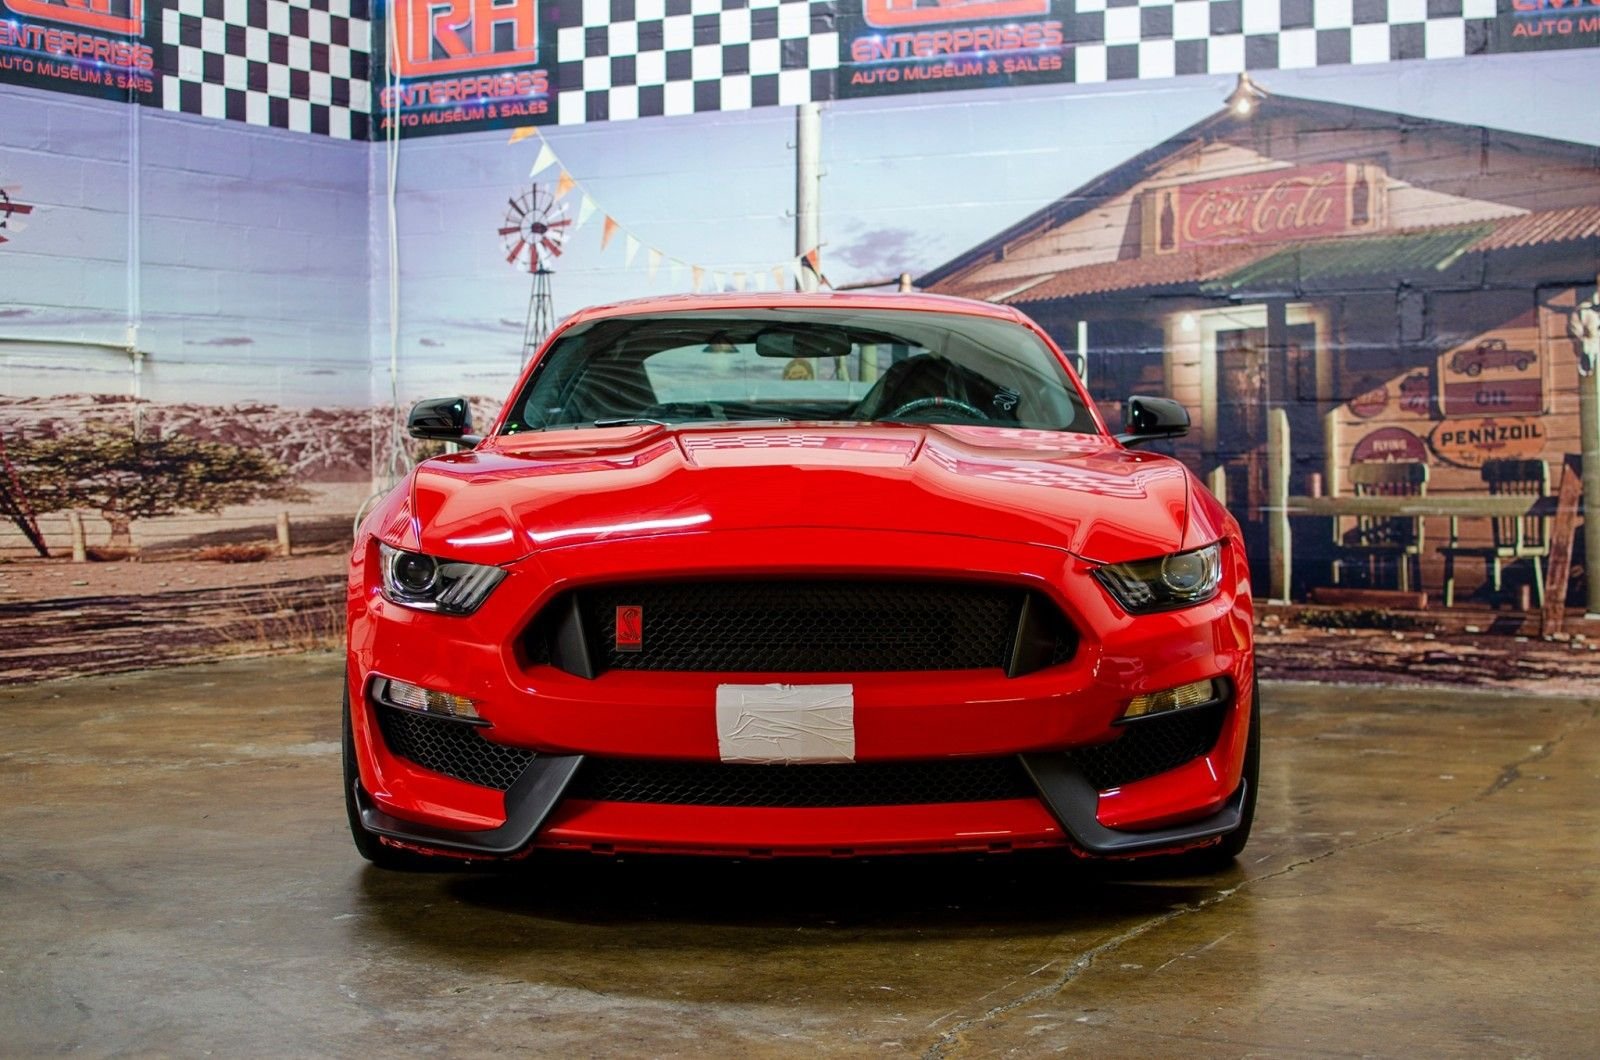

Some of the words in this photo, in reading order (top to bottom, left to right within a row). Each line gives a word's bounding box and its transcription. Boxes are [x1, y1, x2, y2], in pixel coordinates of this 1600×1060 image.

[1512, 19, 1573, 37] AUTO
[851, 21, 1063, 62] ENTERPRISES
[38, 61, 101, 84] MUSEUM
[103, 71, 113, 86] &
[851, 68, 900, 85] AUTO
[903, 62, 983, 80] MUSEUM
[987, 61, 999, 74] &
[1003, 56, 1063, 73] SALES
[380, 69, 548, 108] ENTERPRISES
[422, 108, 484, 125] MUSEUM
[488, 105, 498, 119] &
[503, 101, 548, 117] SALES
[1475, 390, 1512, 406] OIL
[1440, 425, 1543, 447] PENNZOIL
